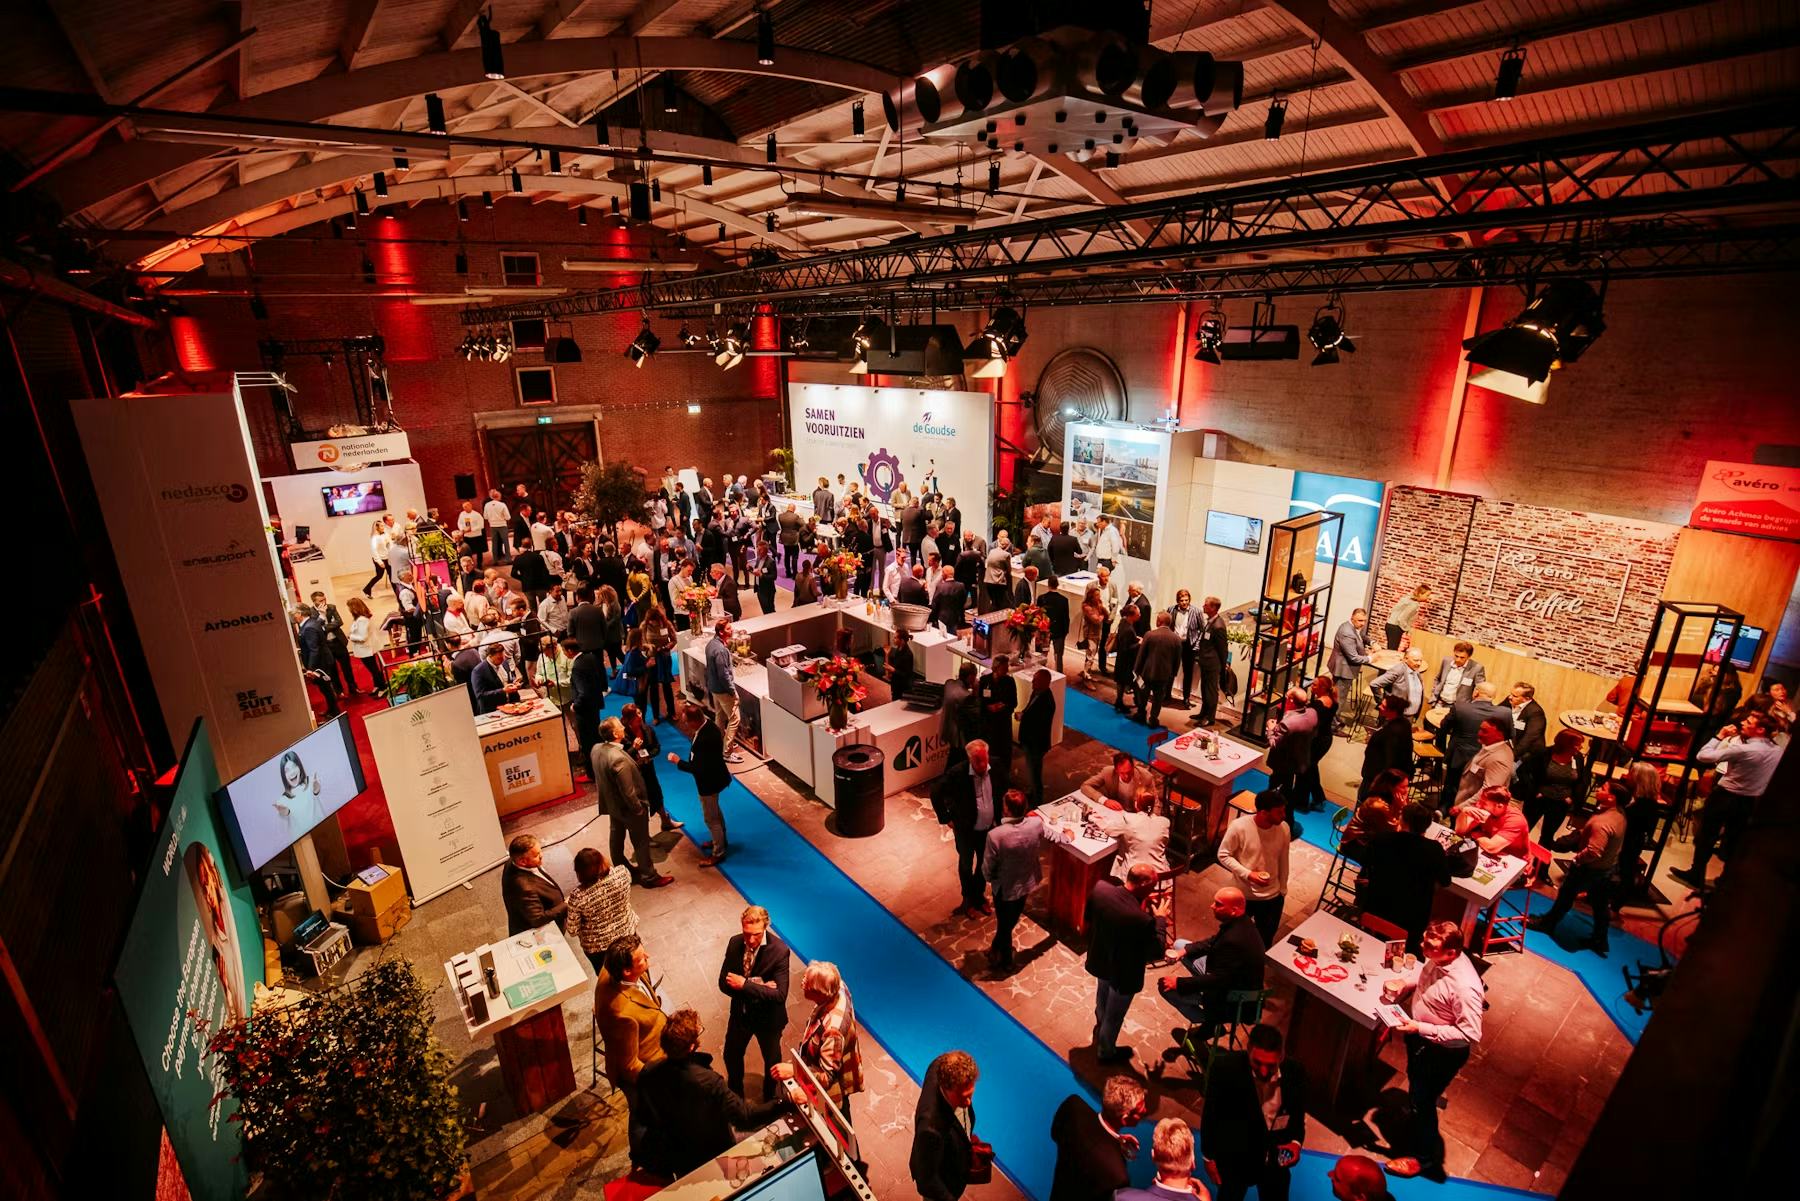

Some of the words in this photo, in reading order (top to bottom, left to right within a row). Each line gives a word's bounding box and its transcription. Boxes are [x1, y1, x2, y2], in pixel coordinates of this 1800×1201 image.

[805, 407, 835, 421] SAMEN
[805, 422, 865, 439] VOORUITZIEN
[913, 422, 923, 433] de
[924, 423, 956, 436] Goudse
[341, 442, 375, 451] nationale
[343, 447, 389, 457] nederlanden
[1733, 478, 1779, 490] avéro
[161, 484, 230, 500] nedasco
[1728, 510, 1762, 520] Achmea
[1515, 589, 1584, 619] Coffee
[204, 611, 275, 632] ArboNext
[236, 690, 257, 701] BE
[239, 696, 273, 711] SUIT
[242, 704, 282, 720] ABLE
[484, 731, 542, 754] ArboNext
[505, 766, 520, 775] BE
[506, 769, 531, 783] SUIT
[508, 775, 536, 790] ABLE
[162, 1006, 180, 1072] Choose
[176, 980, 186, 1008] the
[182, 918, 200, 983] European
